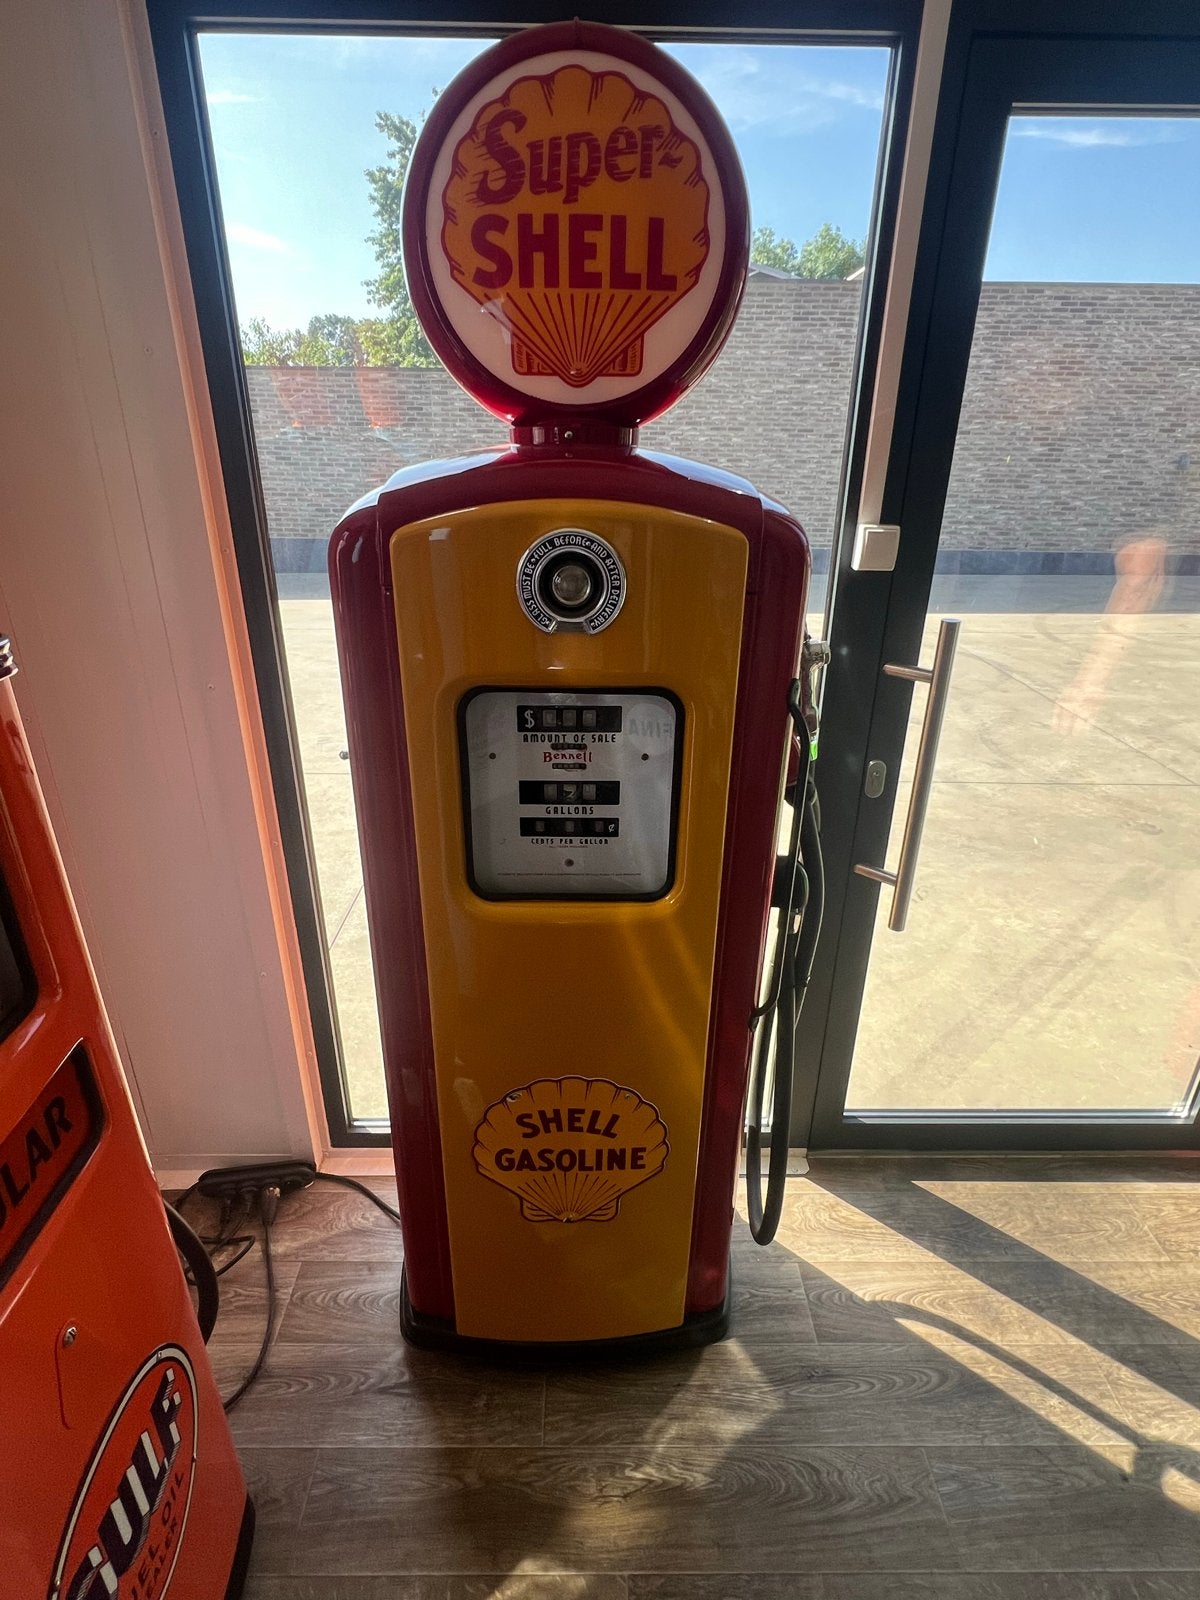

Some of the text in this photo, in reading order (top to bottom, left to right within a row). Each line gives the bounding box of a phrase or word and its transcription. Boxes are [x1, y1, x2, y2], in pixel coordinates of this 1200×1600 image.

[470, 213, 678, 292] SHELL
[522, 536, 620, 627] GLASS MUST BE FULL BEFORE AND AFTER DELIVERY
[524, 709, 535, 729] $
[522, 734, 617, 743] AMOUNT OF SALE
[545, 806, 595, 815] GALLONS
[515, 1108, 621, 1139] SHELL
[0, 1096, 73, 1232] LAR
[494, 1147, 647, 1172] GASOLINE
